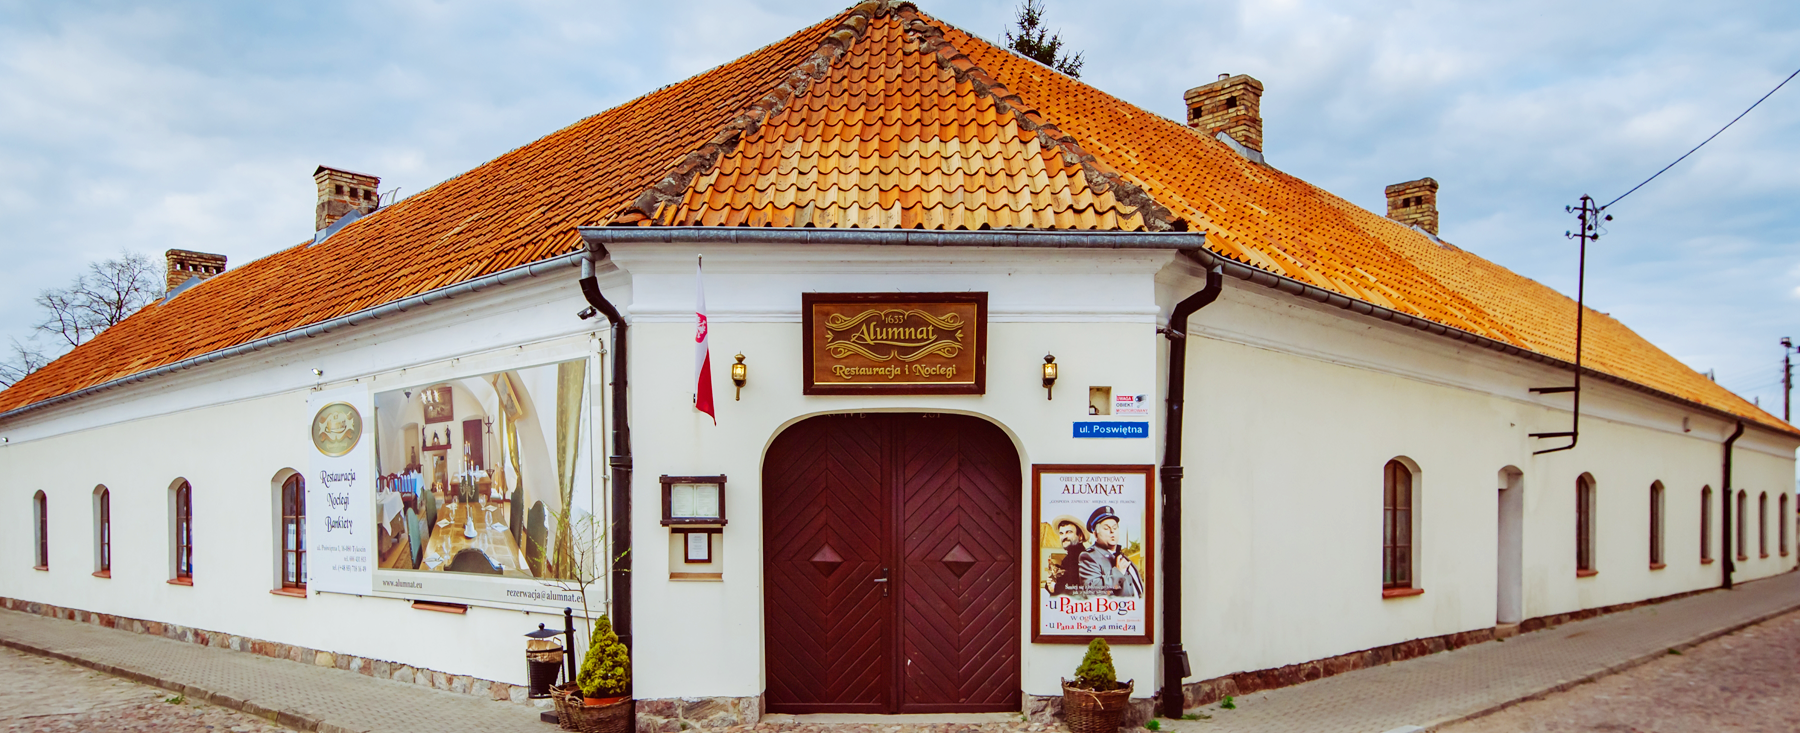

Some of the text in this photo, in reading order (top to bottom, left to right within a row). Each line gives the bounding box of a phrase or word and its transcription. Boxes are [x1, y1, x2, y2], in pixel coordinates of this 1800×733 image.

[885, 315, 904, 324] 1633
[851, 321, 938, 346] Alumnat
[831, 364, 957, 379] Restauracja i Noclegi
[1080, 426, 1090, 434] ul.
[320, 468, 356, 488] Restauracja
[1062, 483, 1124, 496] ALUMNAT
[326, 492, 350, 511] Noclegi
[324, 516, 352, 534] Bankiety
[382, 579, 422, 588] www.alumnat.eu
[1049, 597, 1136, 616] u Pana Boga
[1080, 614, 1112, 622] ogródku
[1056, 622, 1074, 630] Pana
[1076, 622, 1096, 632] Boga
[1108, 622, 1136, 632] miedzą
